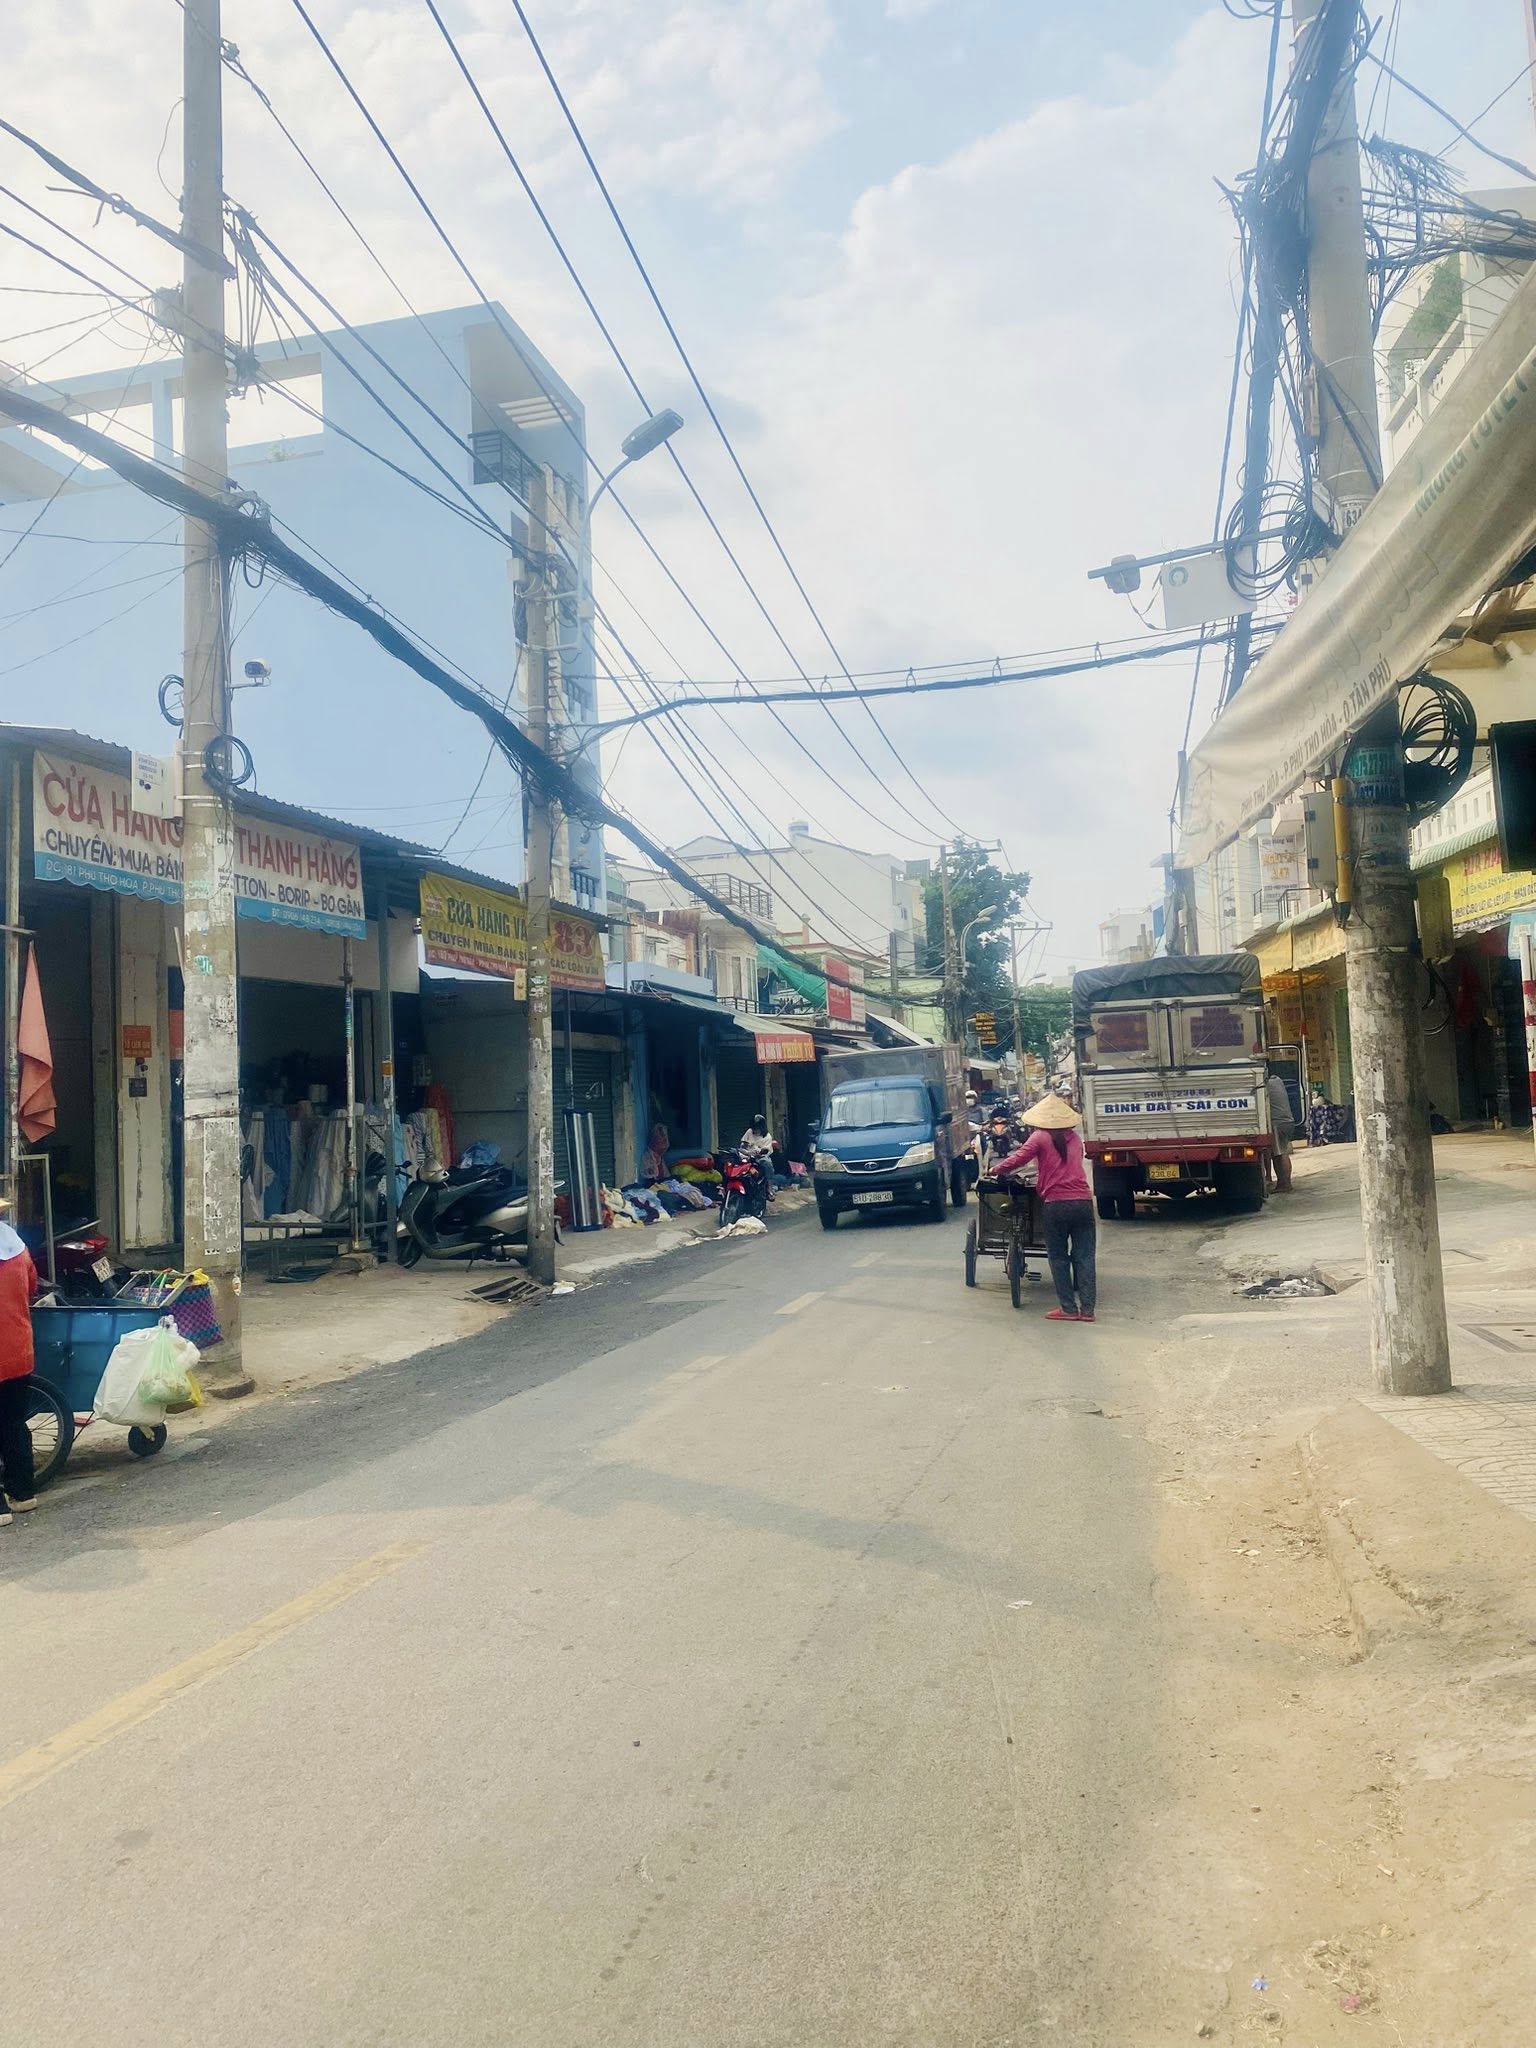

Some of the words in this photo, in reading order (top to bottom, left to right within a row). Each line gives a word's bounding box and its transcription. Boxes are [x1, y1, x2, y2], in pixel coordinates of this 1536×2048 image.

[43, 763, 105, 830] CỬA
[119, 846, 152, 876] MUA
[234, 826, 303, 878] THANH
